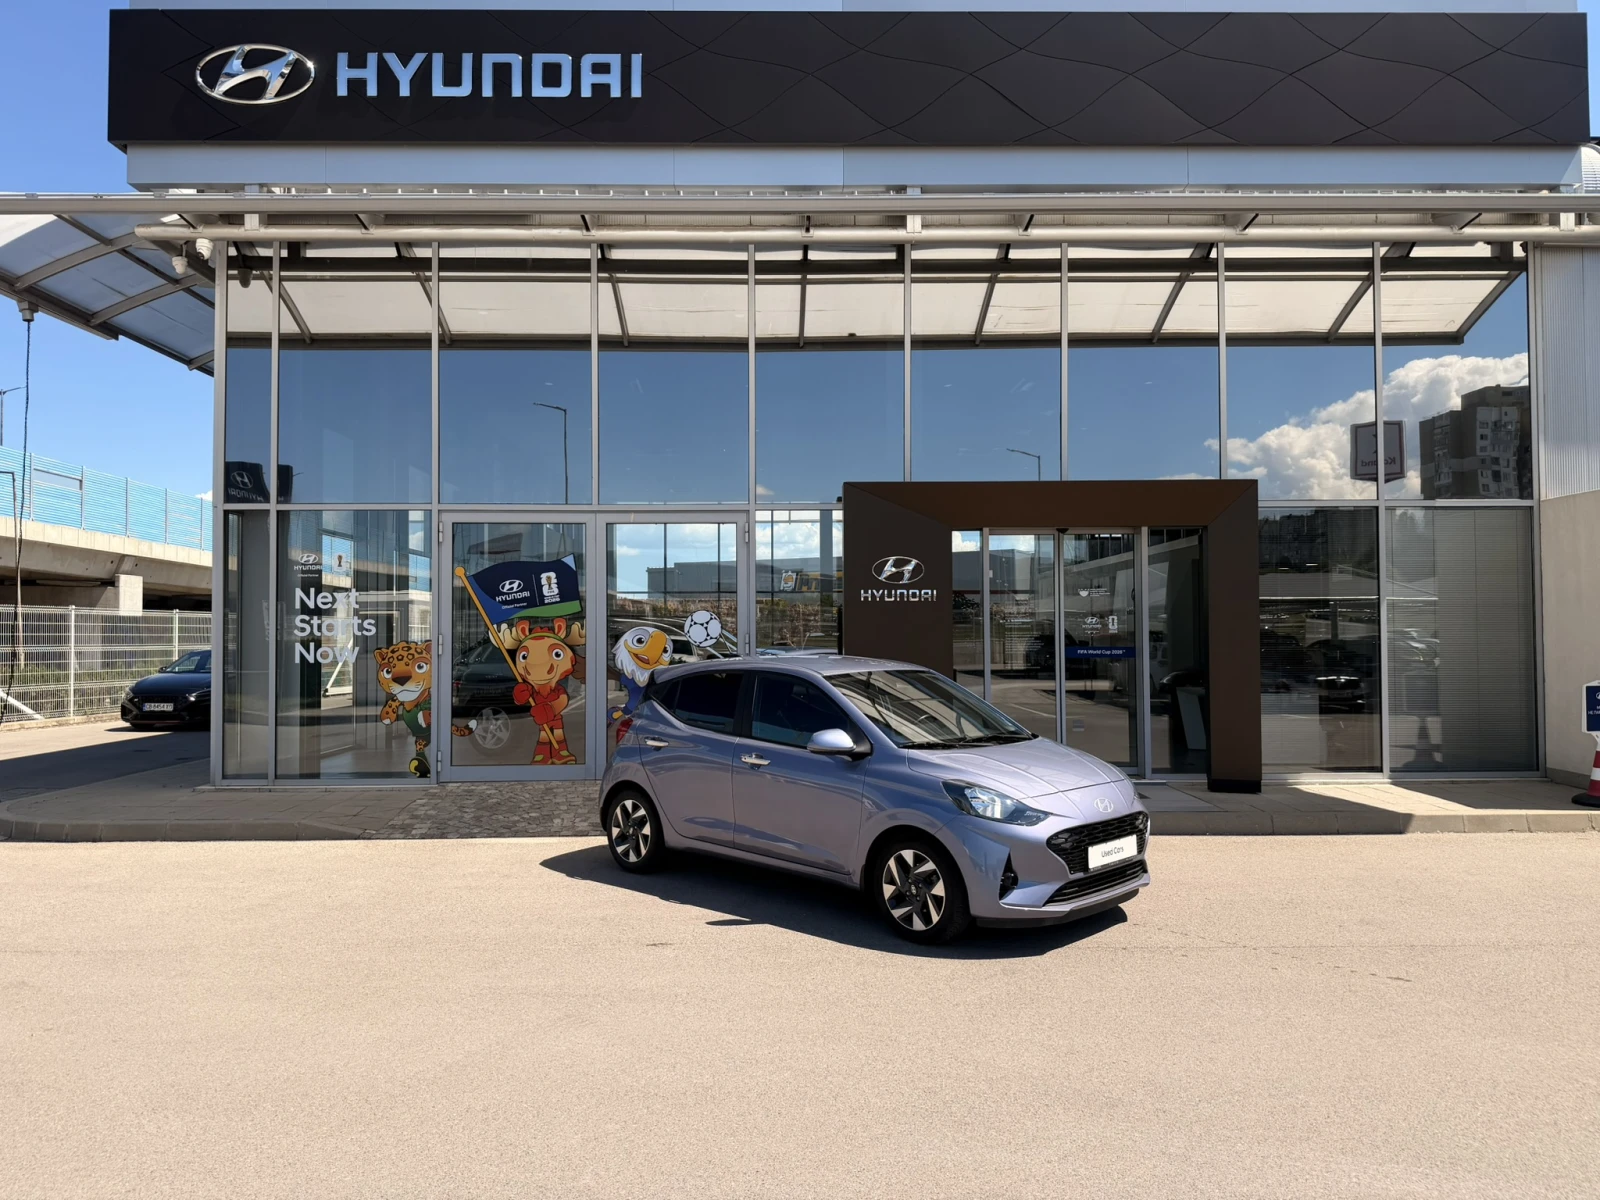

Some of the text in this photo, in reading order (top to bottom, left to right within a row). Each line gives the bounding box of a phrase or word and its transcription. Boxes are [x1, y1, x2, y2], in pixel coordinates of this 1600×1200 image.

[337, 52, 642, 98] HYUNDAI
[295, 588, 360, 609] Next
[496, 591, 531, 602] HYUNDAI
[860, 589, 937, 602] HYUNDAI
[294, 614, 377, 637] Starts
[295, 642, 360, 664] Now
[1101, 846, 1124, 858] Used Cars
